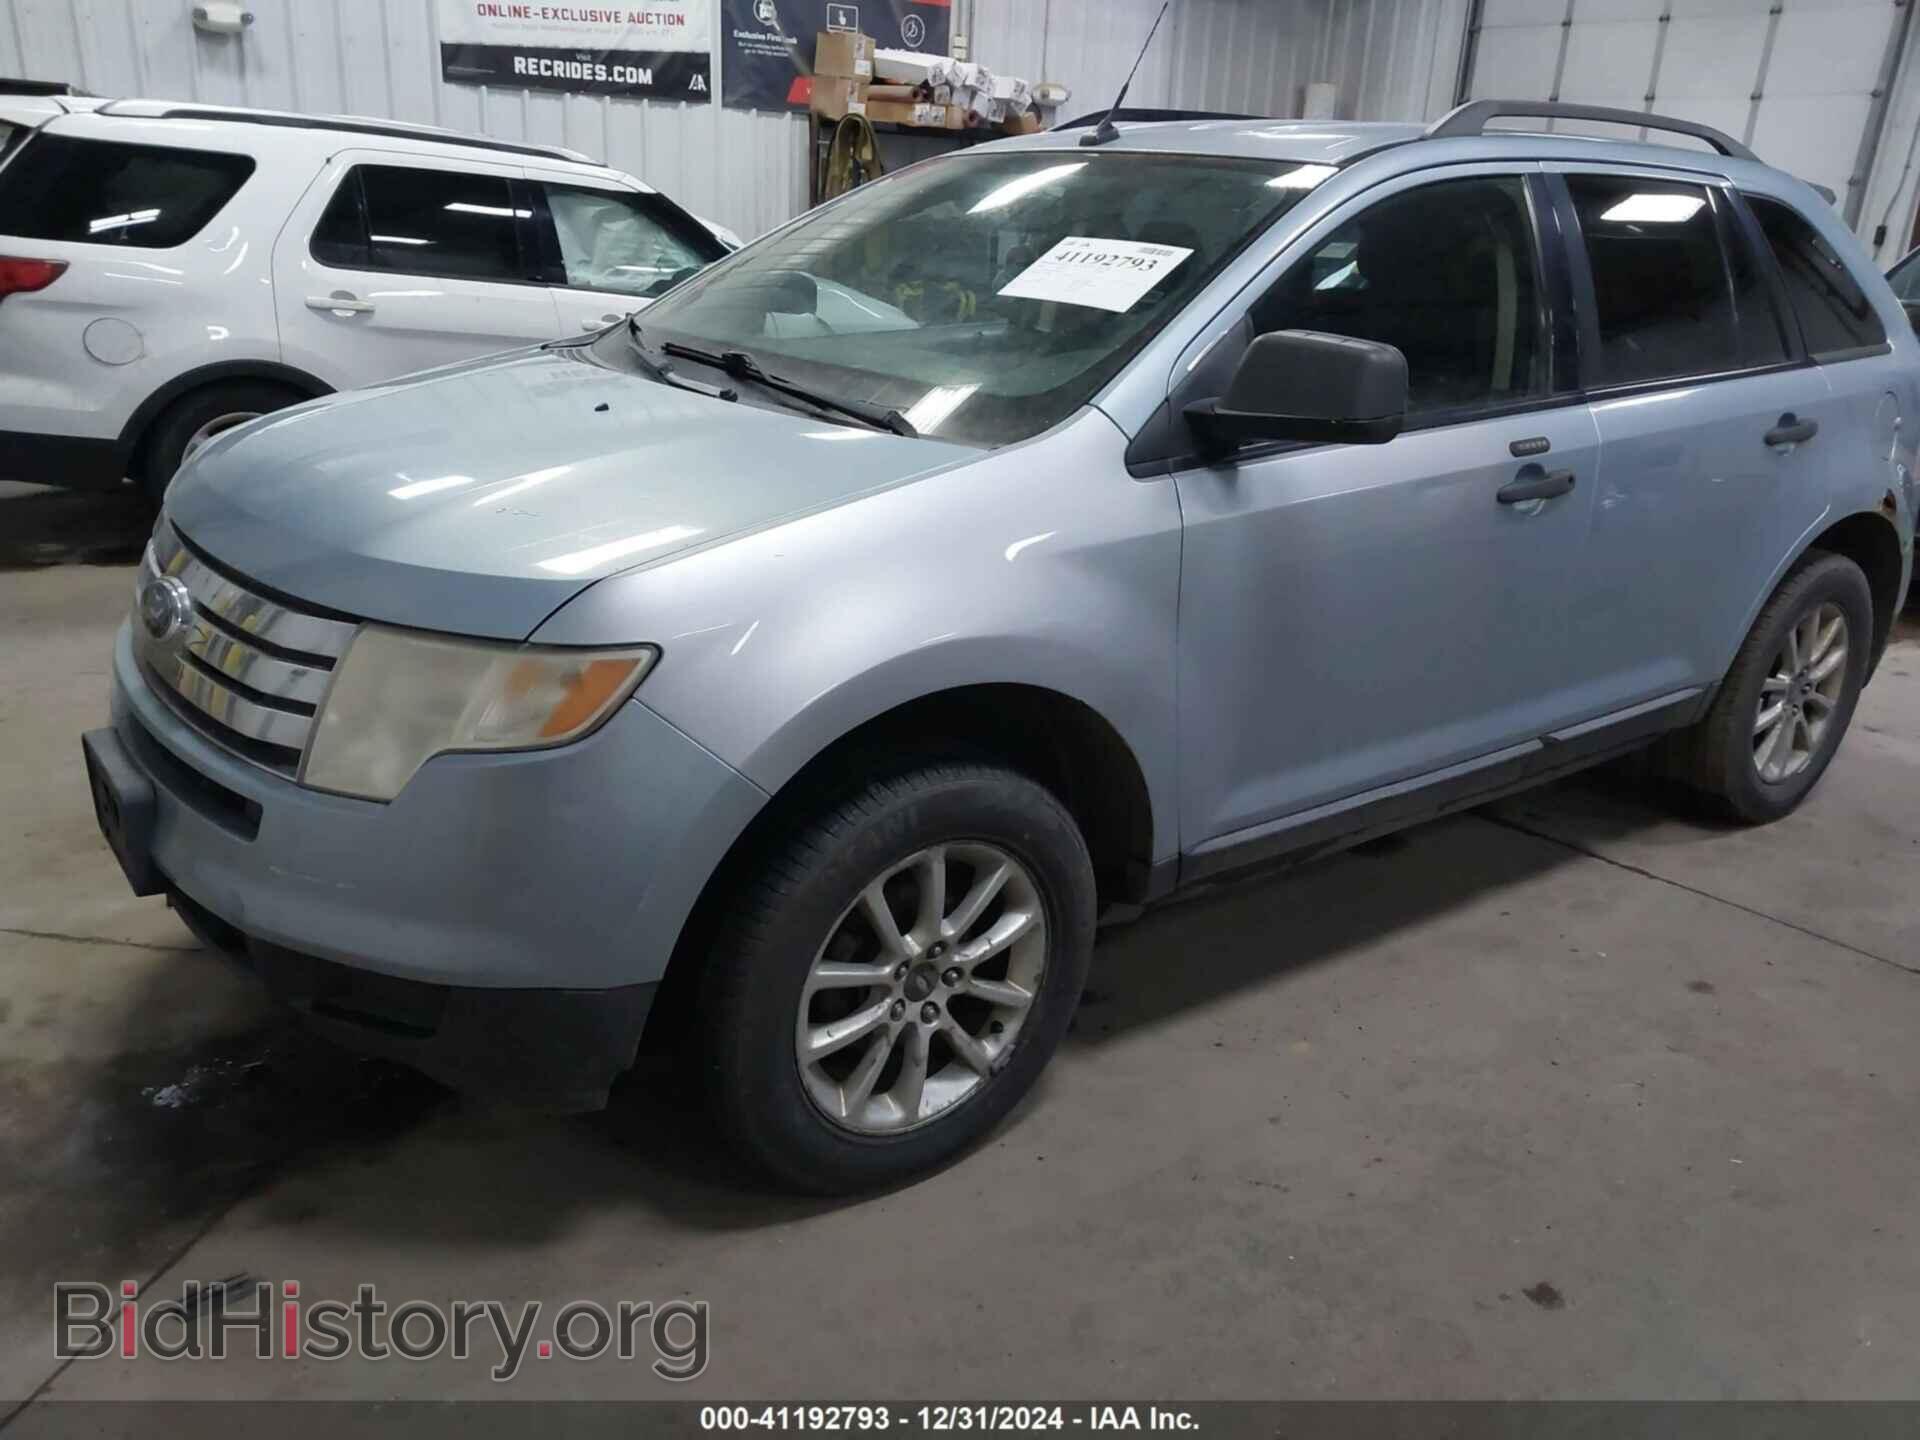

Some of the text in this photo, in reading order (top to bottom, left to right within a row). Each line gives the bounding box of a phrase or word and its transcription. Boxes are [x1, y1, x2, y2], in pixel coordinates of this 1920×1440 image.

[477, 4, 686, 26] ONLINE-EXCLUSIVE AUCTION
[513, 56, 653, 85] RECRIDES.COM
[1056, 251, 1158, 271] 41192793
